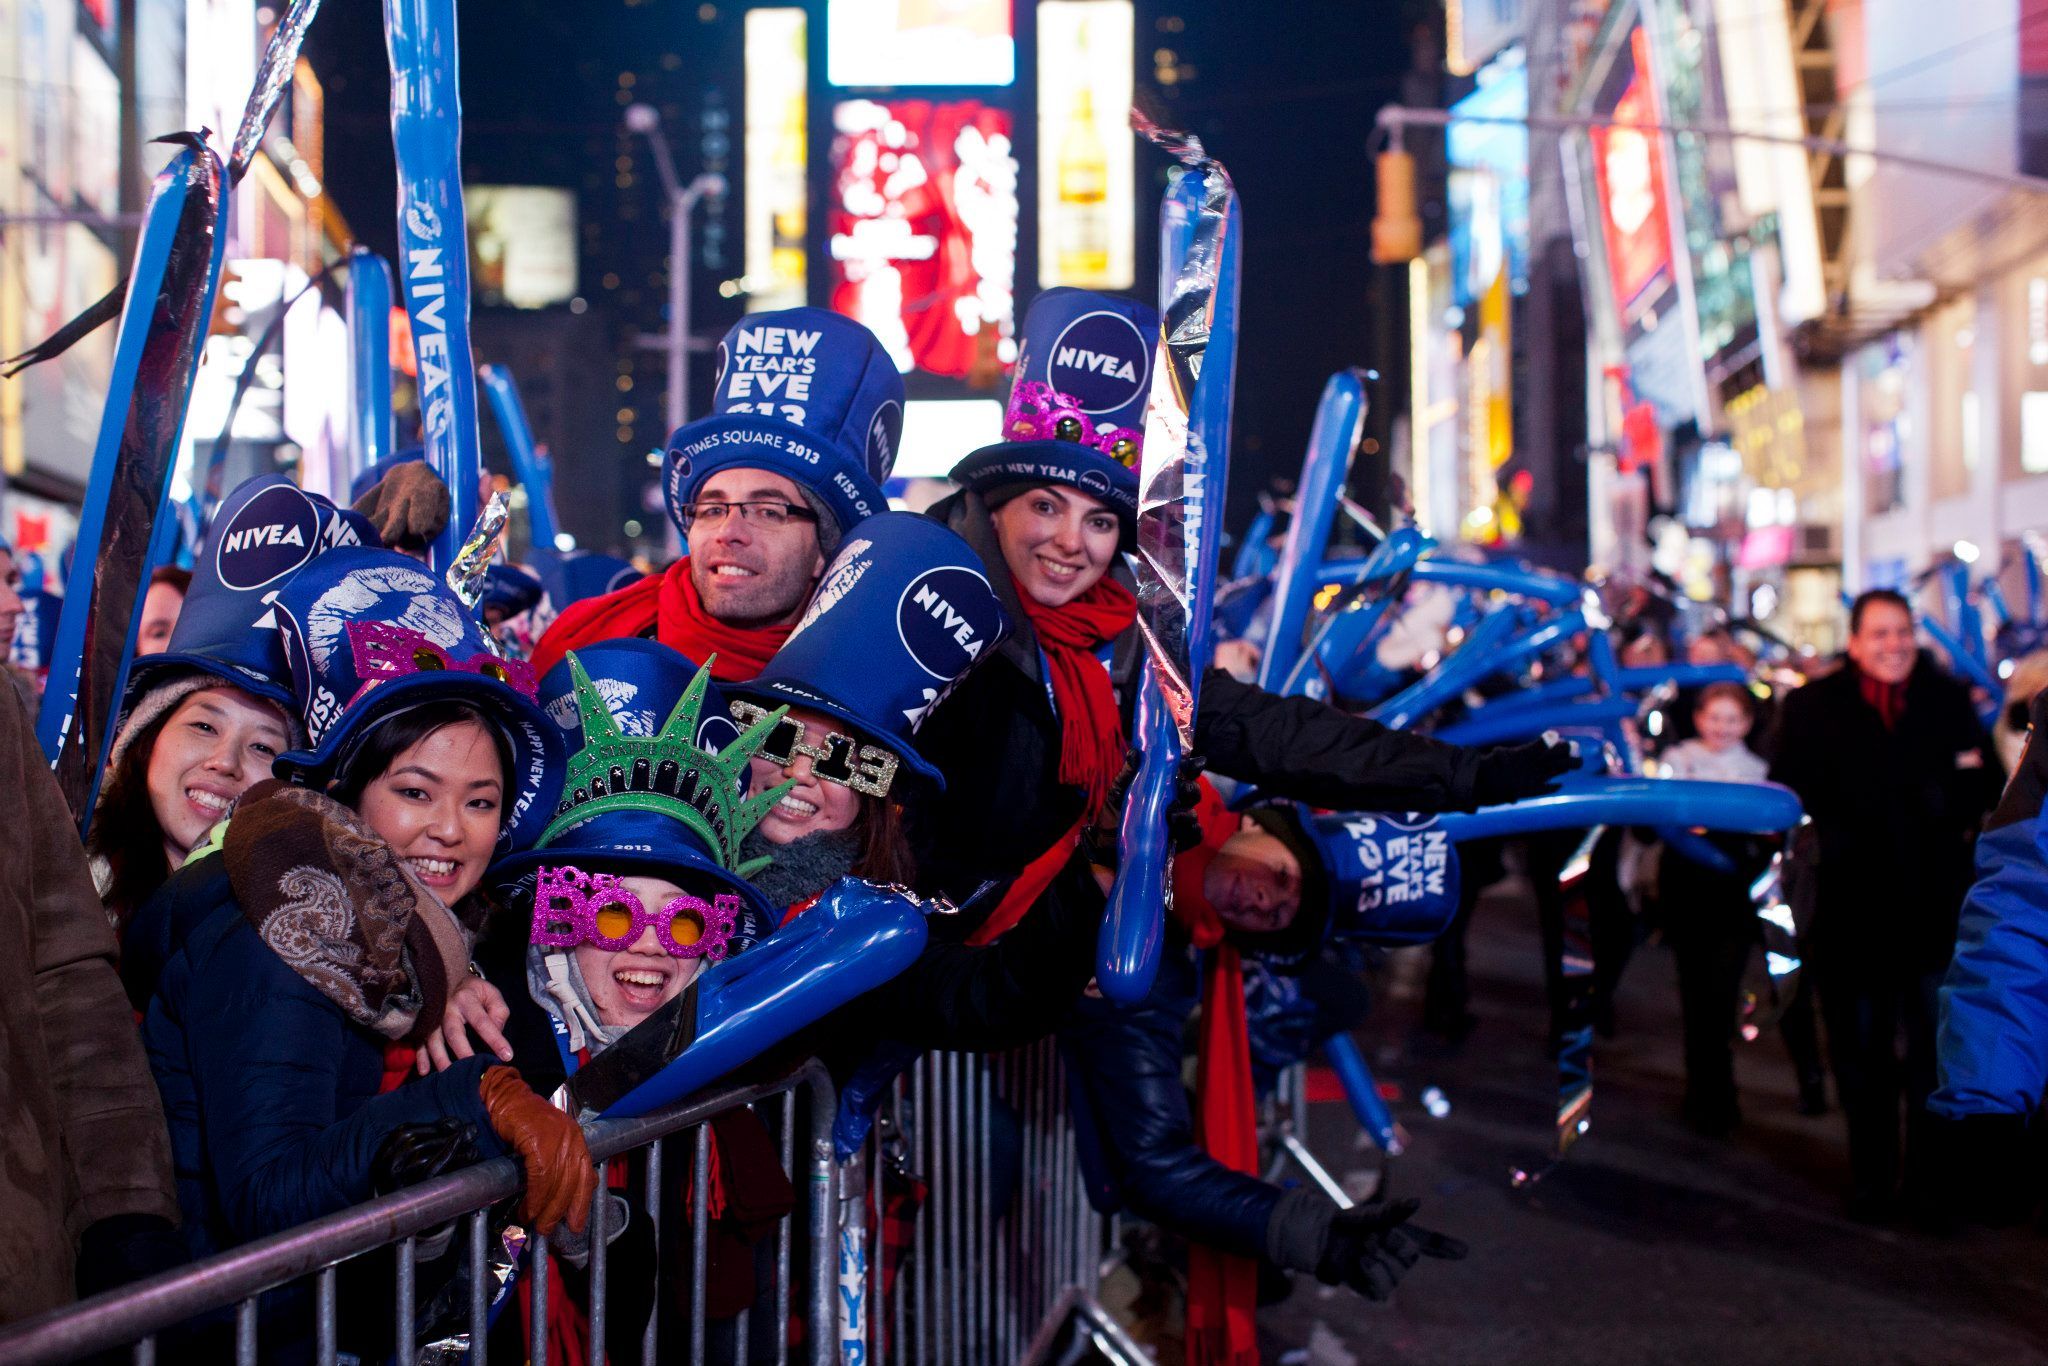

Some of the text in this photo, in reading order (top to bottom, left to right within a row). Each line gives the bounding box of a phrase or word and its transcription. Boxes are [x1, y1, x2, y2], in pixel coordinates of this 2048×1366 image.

[408, 248, 450, 397] NIVEA
[735, 327, 823, 356] NEW
[734, 355, 817, 375] YEAR'S
[1056, 346, 1137, 384] NIVEA
[727, 372, 813, 402] EVE
[684, 430, 820, 465] TIMES SQUARE 2013
[833, 471, 860, 500] KISS
[1006, 463, 1035, 474] NEW
[1040, 464, 1077, 482] YEAR
[1081, 476, 1106, 492] NIVEA
[225, 524, 304, 554] NIVEA
[912, 583, 984, 662] NIVEA
[307, 685, 336, 747] KISS
[600, 742, 658, 758] STATUE
[660, 743, 681, 757] OF
[508, 721, 545, 828] HAPPY NEW YEAR
[613, 844, 652, 852] 2013
[1343, 817, 1384, 912] 2013
[1423, 830, 1448, 895] NEW
[1386, 835, 1410, 905] EVE
[1409, 833, 1424, 901] YEAR'S
[531, 885, 715, 960] BOO
